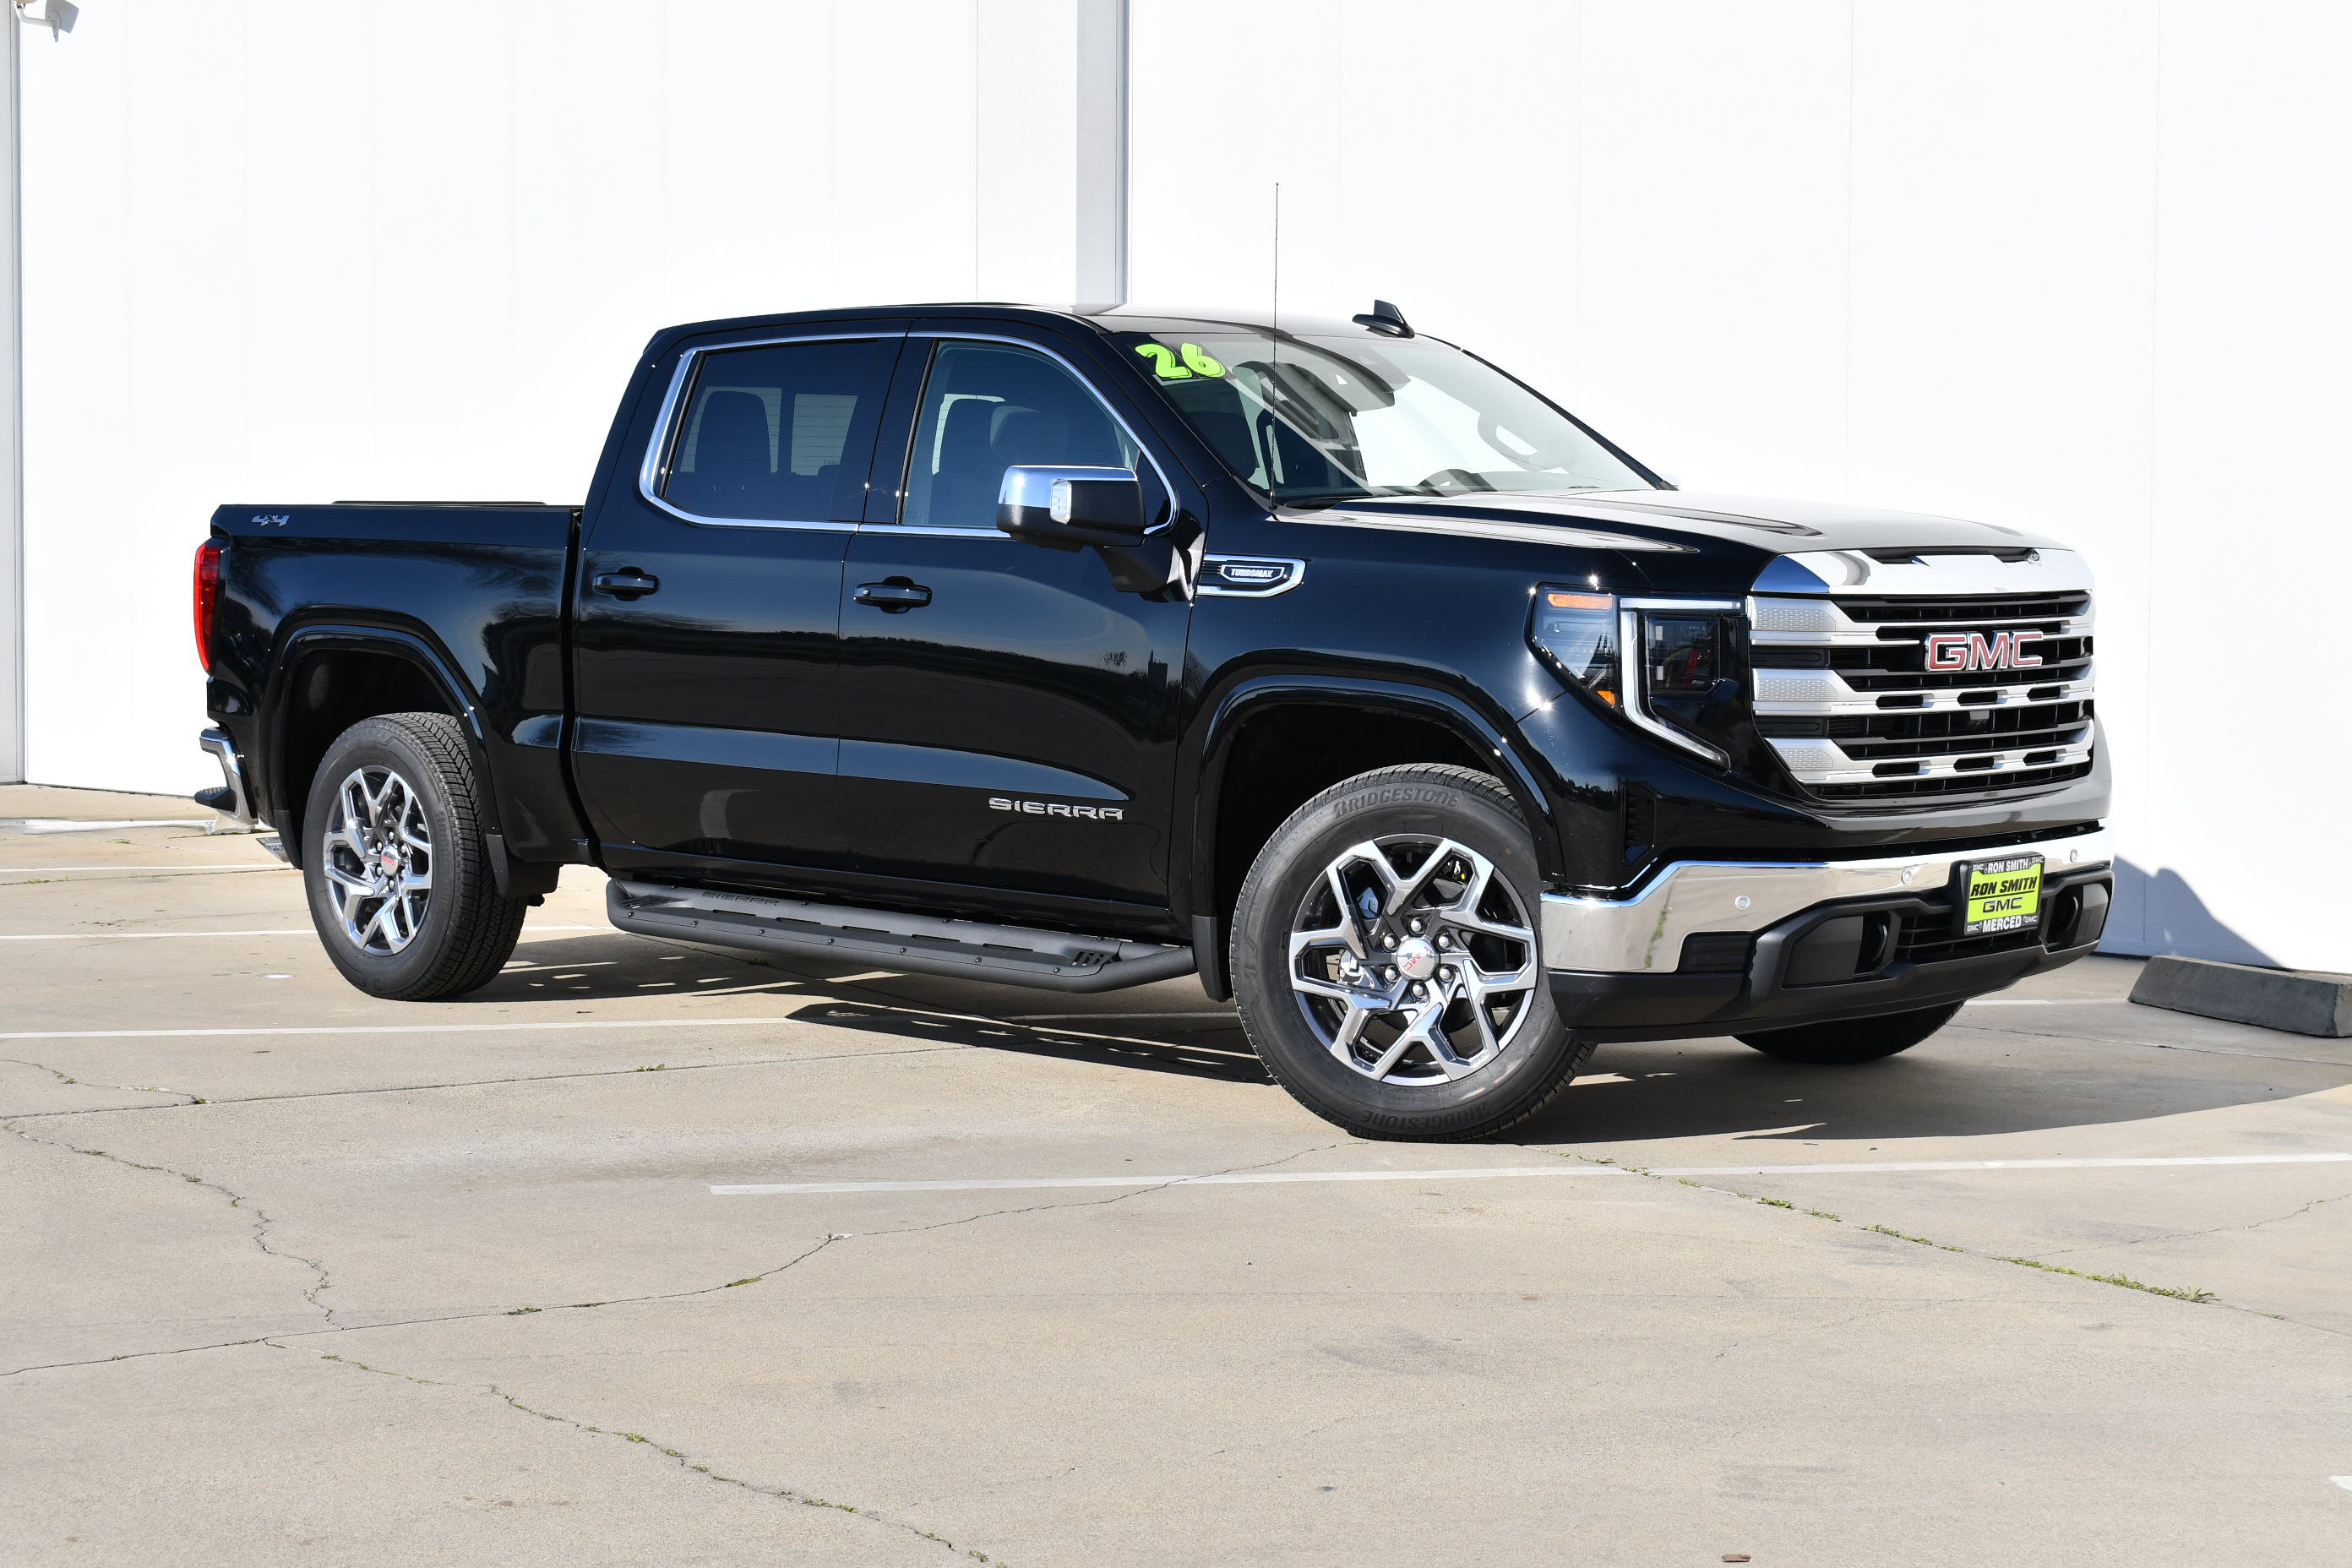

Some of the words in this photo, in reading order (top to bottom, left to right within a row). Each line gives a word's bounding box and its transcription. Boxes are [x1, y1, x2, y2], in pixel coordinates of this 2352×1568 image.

[1135, 342, 1226, 379] 26
[1925, 629, 2044, 672] GMC
[988, 798, 1124, 820] SIERRA
[1333, 787, 1461, 819] BRIDGESTONE
[1988, 862, 2006, 874] RON
[2006, 858, 2028, 872] SMITH
[1970, 882, 1997, 896] RON
[2000, 876, 2038, 893] SMITH
[1983, 896, 2023, 912] GMC
[1983, 916, 2022, 933] MERCED
